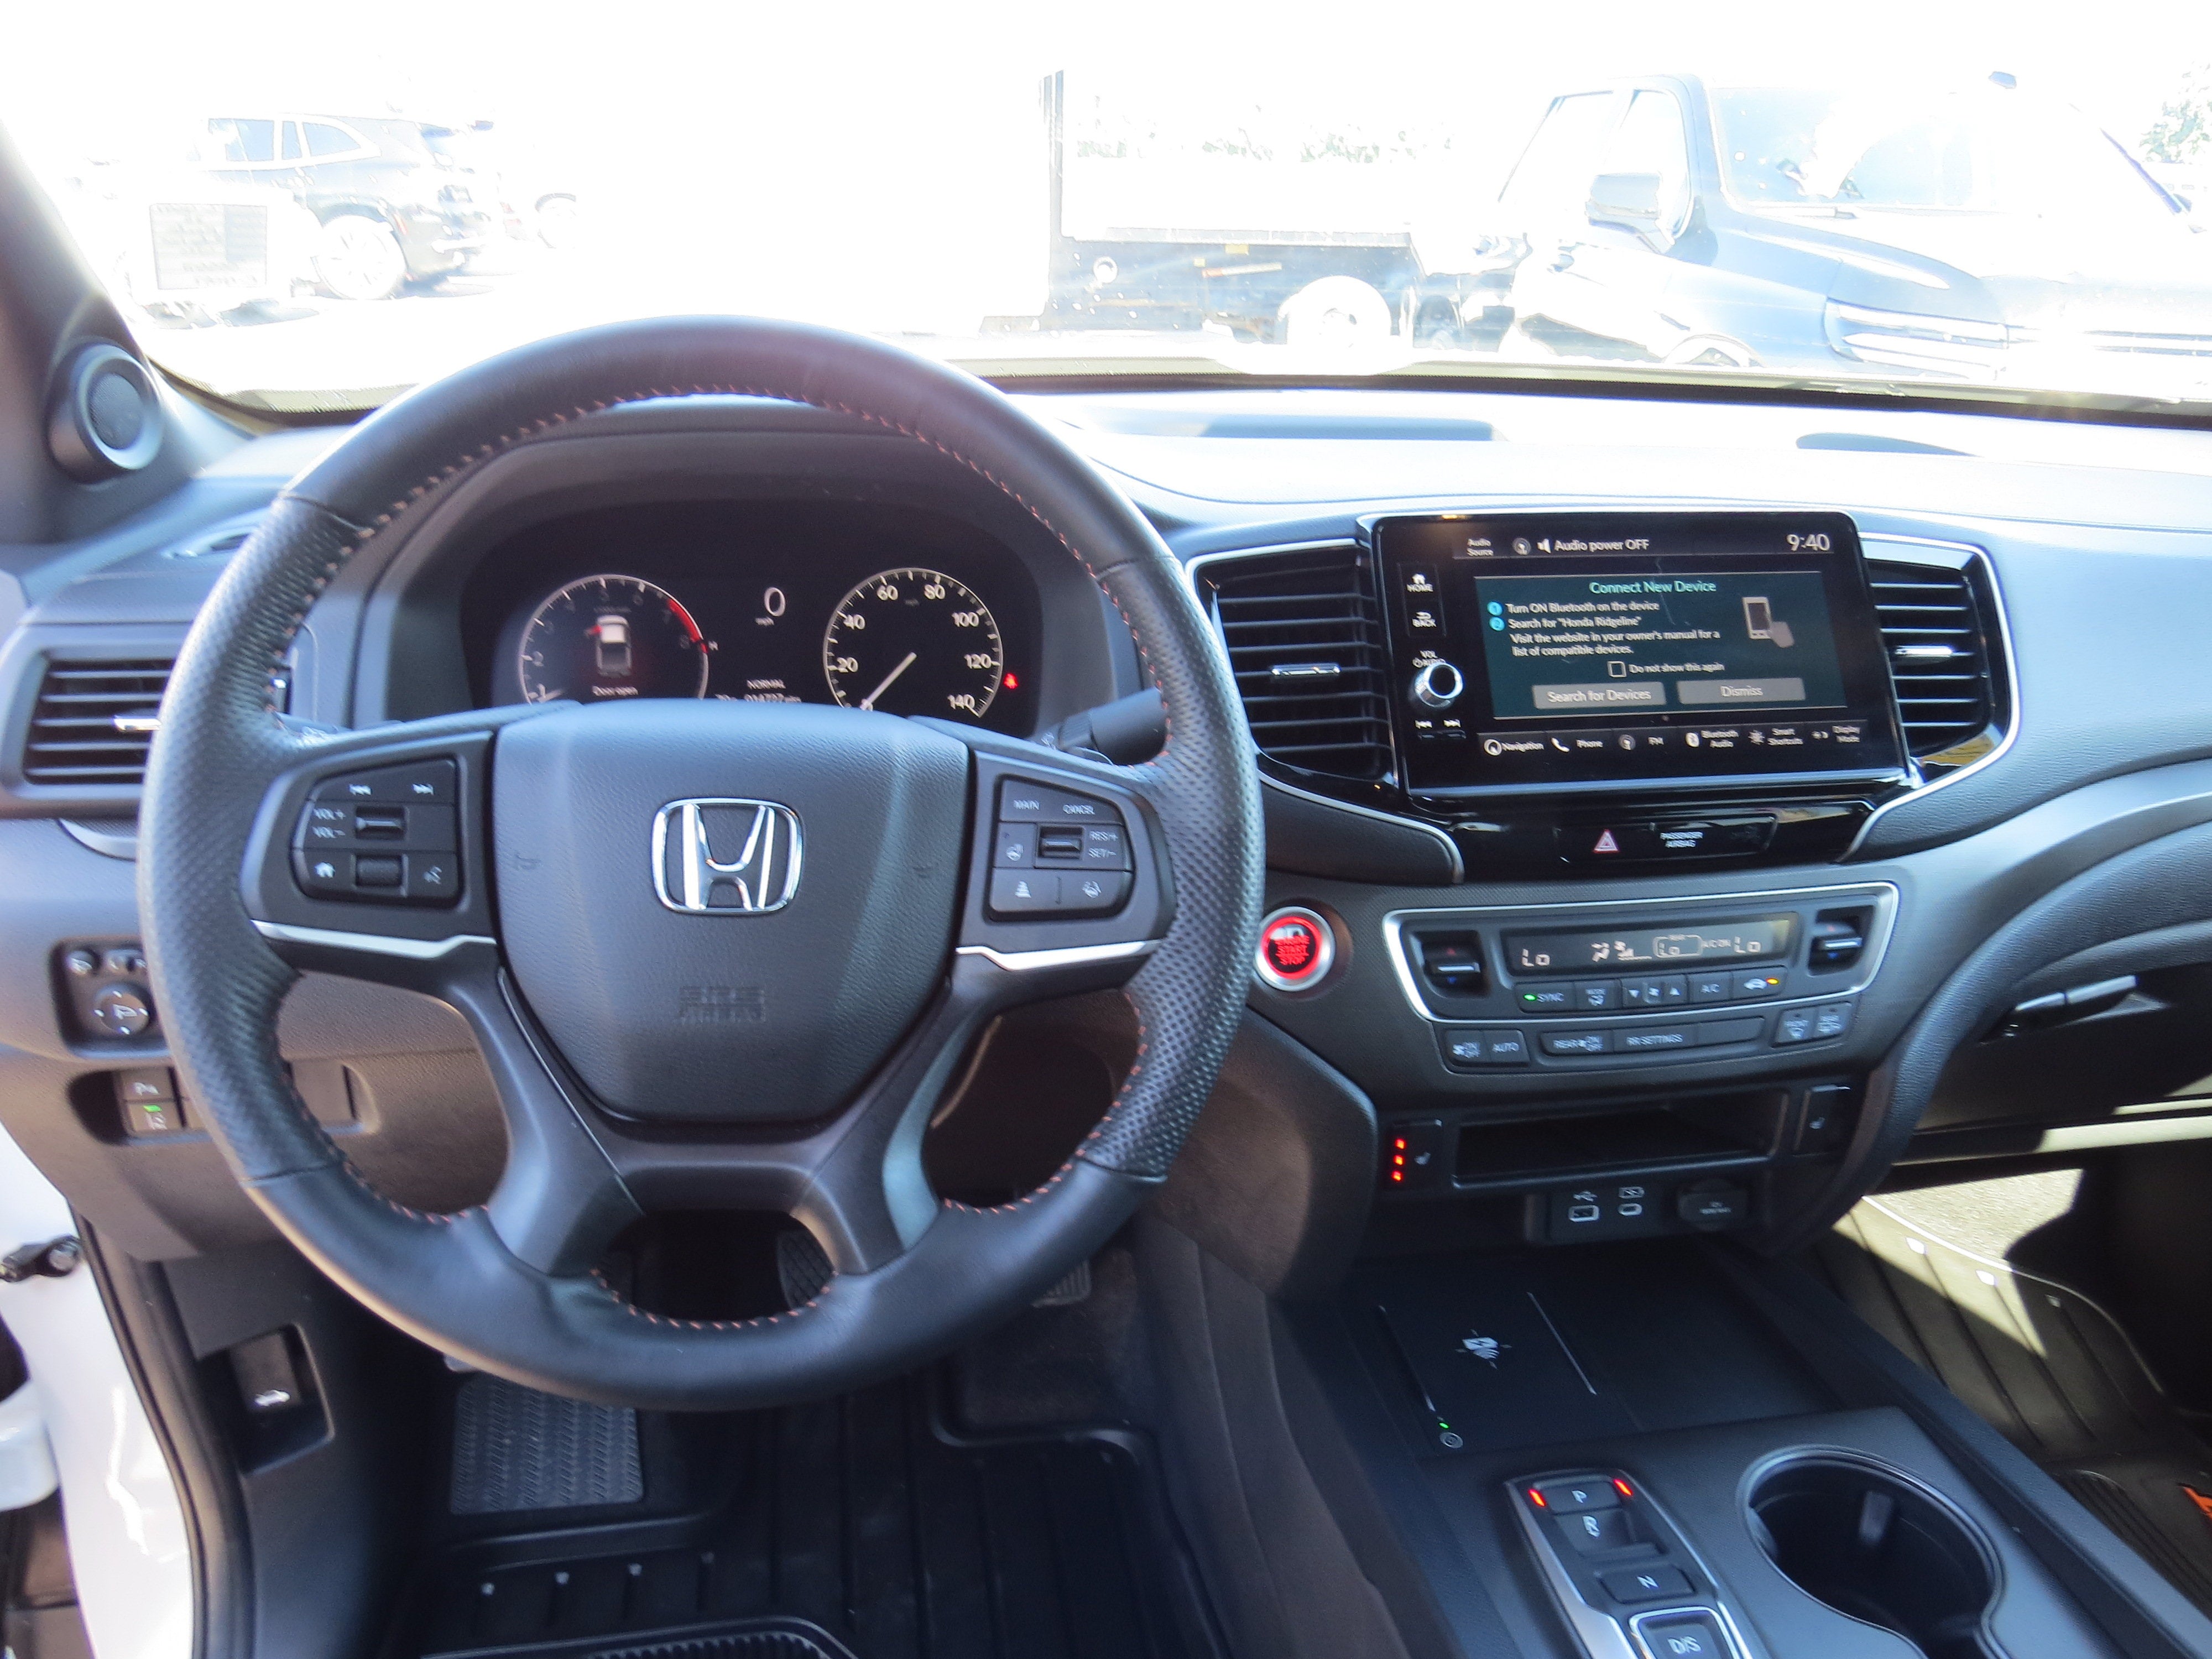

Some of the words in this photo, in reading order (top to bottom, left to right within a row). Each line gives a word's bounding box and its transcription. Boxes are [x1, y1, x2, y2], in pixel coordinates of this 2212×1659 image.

[1554, 540, 1588, 552] Audio
[1588, 541, 1624, 552] power
[1625, 539, 1650, 550] OFF
[1786, 534, 1830, 552] 9:40
[877, 585, 899, 601] 60
[924, 583, 946, 600] 80
[1407, 583, 1434, 592] HOME
[1589, 582, 1642, 594] Connect
[1643, 581, 1672, 593] New
[1673, 580, 1717, 593] Device
[764, 587, 786, 617] 0
[1505, 603, 1530, 614] Turn
[1529, 603, 1548, 613] ON
[1548, 601, 1597, 613] Bluetooth
[1597, 603, 1611, 612] on
[1611, 601, 1629, 611] the
[1628, 601, 1660, 611] device
[843, 613, 866, 630] 40
[951, 611, 979, 627] 100
[1508, 618, 1541, 629] Search
[1541, 618, 1557, 628] for
[1509, 633, 1535, 644] Visit
[1534, 633, 1552, 643] the
[1552, 632, 1590, 643] website
[1590, 632, 1601, 641] in
[1601, 633, 1625, 643] your
[1625, 630, 1663, 641] owner's
[1662, 629, 1698, 640] manual
[1697, 629, 1713, 639] for
[1512, 646, 1529, 657] list
[1529, 646, 1541, 656] of
[1541, 645, 1594, 657] compatible
[1594, 644, 1635, 655] devices.
[836, 657, 858, 673] 20
[964, 653, 993, 669] 120
[1629, 664, 1644, 674] Do
[1644, 664, 1661, 673] not
[1660, 663, 1684, 673] show
[1684, 662, 1702, 672] this
[1702, 662, 1725, 673] again
[747, 679, 786, 690] NORMAL
[1720, 685, 1764, 697] Dismiss
[947, 693, 975, 710] 140
[1547, 690, 1587, 703] Search
[1587, 690, 1606, 701] for
[1606, 688, 1652, 701] Devices
[1501, 741, 1545, 752] Navigation
[1013, 800, 1040, 811] MAIN
[1571, 1489, 1588, 1504] P
[1636, 1574, 1659, 1589] N
[1667, 1636, 1702, 1655] D/S
